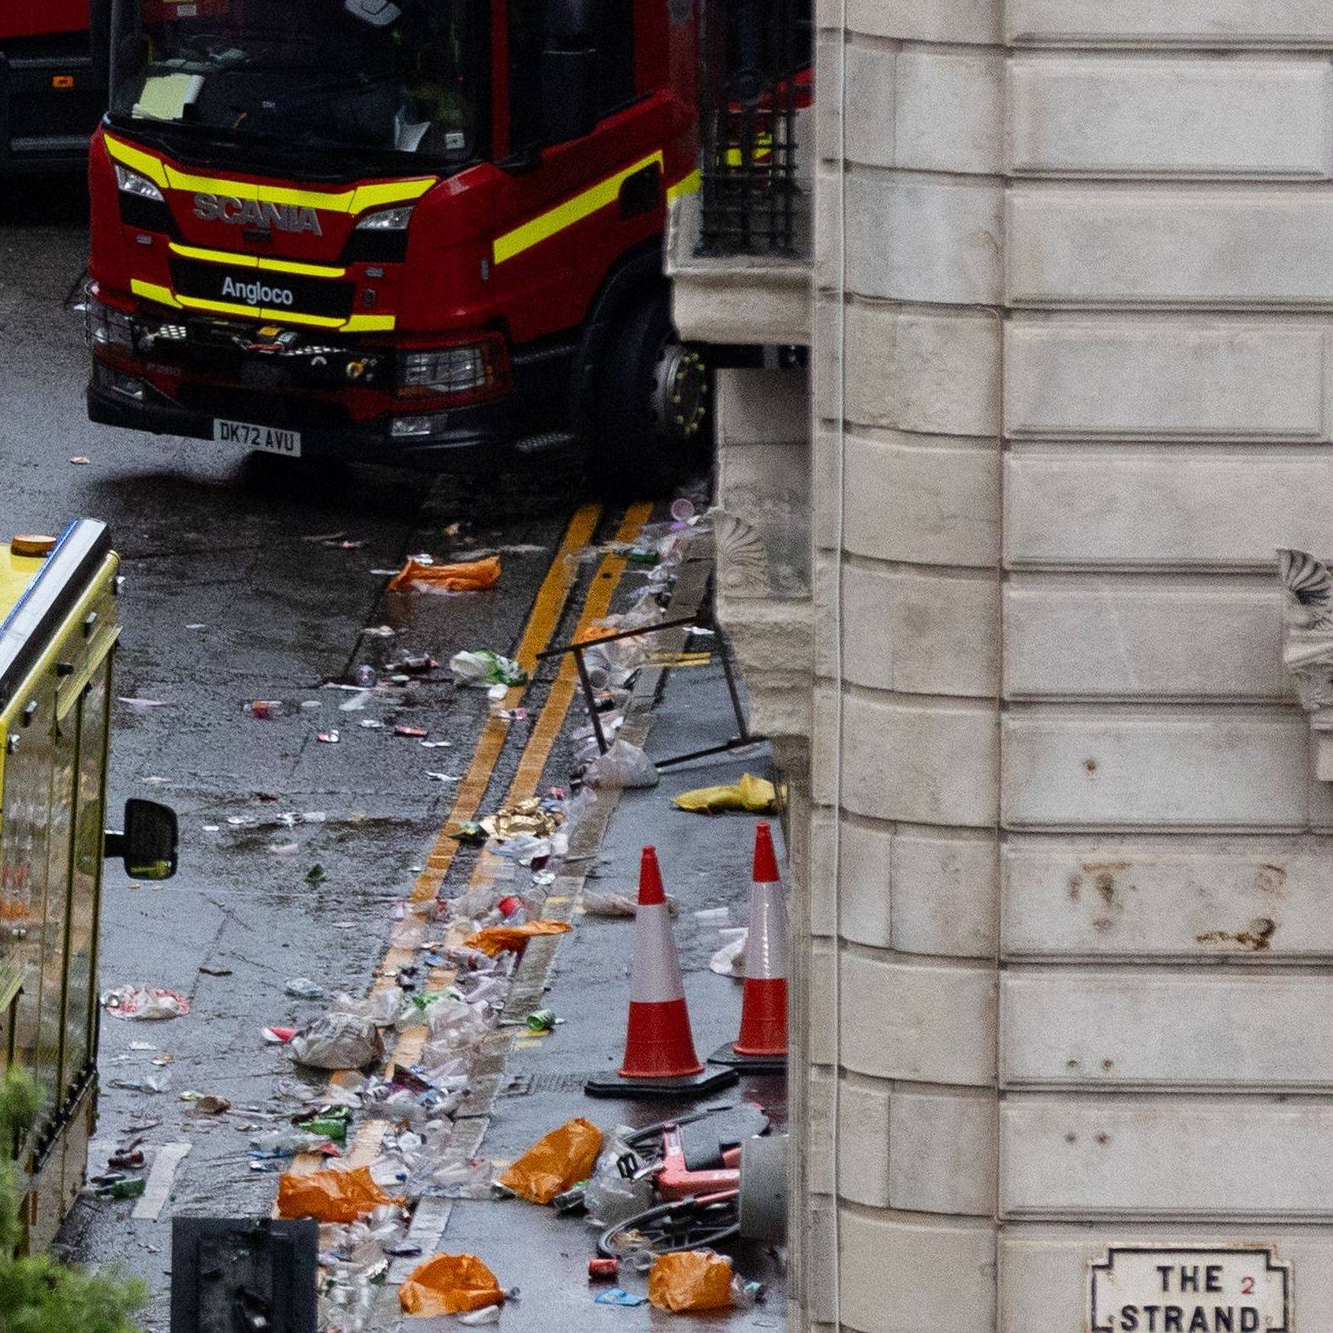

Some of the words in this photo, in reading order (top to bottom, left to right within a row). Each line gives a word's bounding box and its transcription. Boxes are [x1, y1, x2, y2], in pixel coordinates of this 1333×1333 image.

[193, 193, 323, 236] SCANIA
[222, 277, 294, 305] Angloco
[220, 422, 260, 446] DK72
[265, 432, 294, 451] AVU
[1157, 1266, 1223, 1292] THE
[1241, 1276, 1255, 1295] 2
[1121, 1304, 1260, 1333] STRAND
